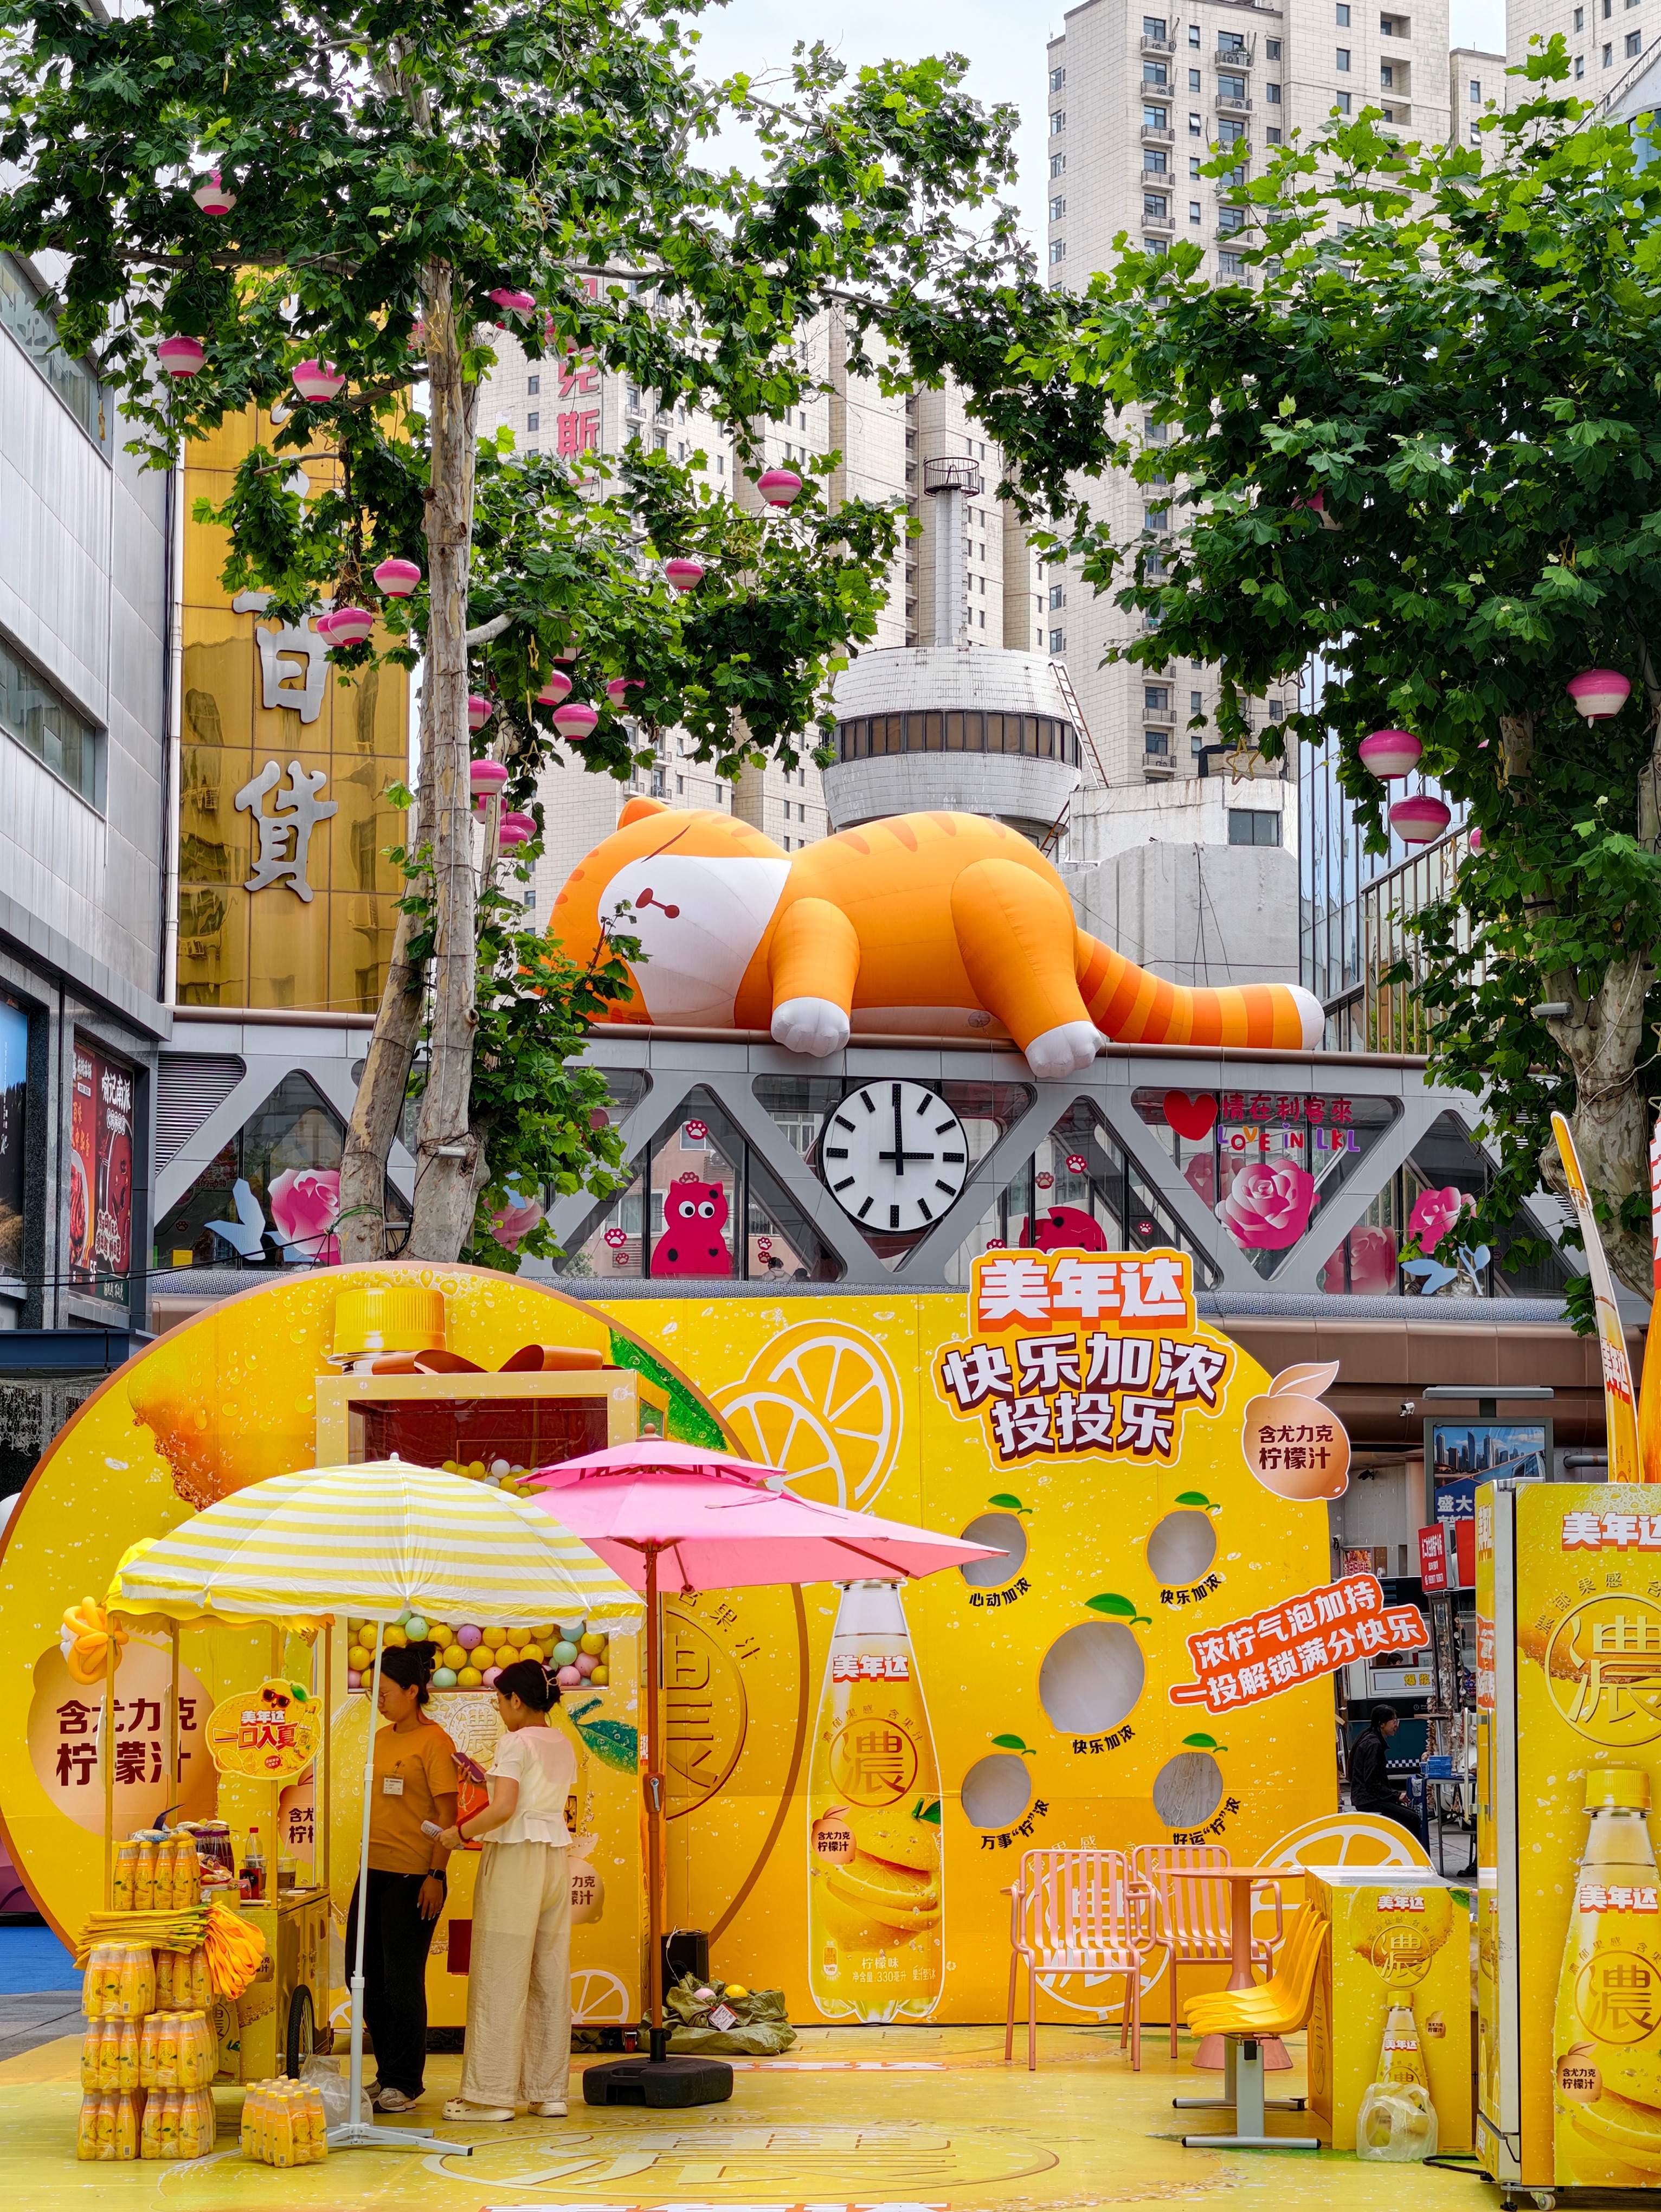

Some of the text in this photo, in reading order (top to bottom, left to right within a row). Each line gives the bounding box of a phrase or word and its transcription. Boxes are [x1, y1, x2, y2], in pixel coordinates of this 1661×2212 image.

[1220, 1093, 1353, 1124] 情在利客來
[1218, 1124, 1271, 1151] LOVE
[1316, 1128, 1361, 1152] LKL
[978, 1259, 1186, 1323] 美年达
[942, 1333, 1226, 1411] 快乐加浓
[990, 1393, 1175, 1460] 投投乐
[1258, 1425, 1333, 1443] 含尤力克
[1259, 1446, 1331, 1470] 柠檬汁
[1438, 1495, 1472, 1513] 盛大
[1563, 1512, 1661, 1548] 美年达
[969, 1577, 1032, 1607] 心动加浓
[1161, 1573, 1221, 1605] 快乐加浓
[1194, 1581, 1376, 1669] 浓柠气泡加持
[833, 1655, 910, 1680] 美年达
[1177, 1612, 1422, 1707] 一投解锁满分快乐
[241, 1711, 285, 1724] 美年达
[213, 1722, 298, 1751] 一口入夏
[1072, 1725, 1136, 1755] 快乐加浓
[817, 1831, 850, 1840] 含尤力克
[817, 1841, 848, 1852] 柠檬汁
[1377, 1895, 1425, 1912] 美年达
[1580, 1885, 1658, 1911] 美年达
[862, 1957, 899, 1970] 柠檬味
[1385, 2039, 1418, 2051] 美年达
[1562, 2068, 1596, 2078] 含尤力克
[1562, 2078, 1595, 2089] 柠檬汁
